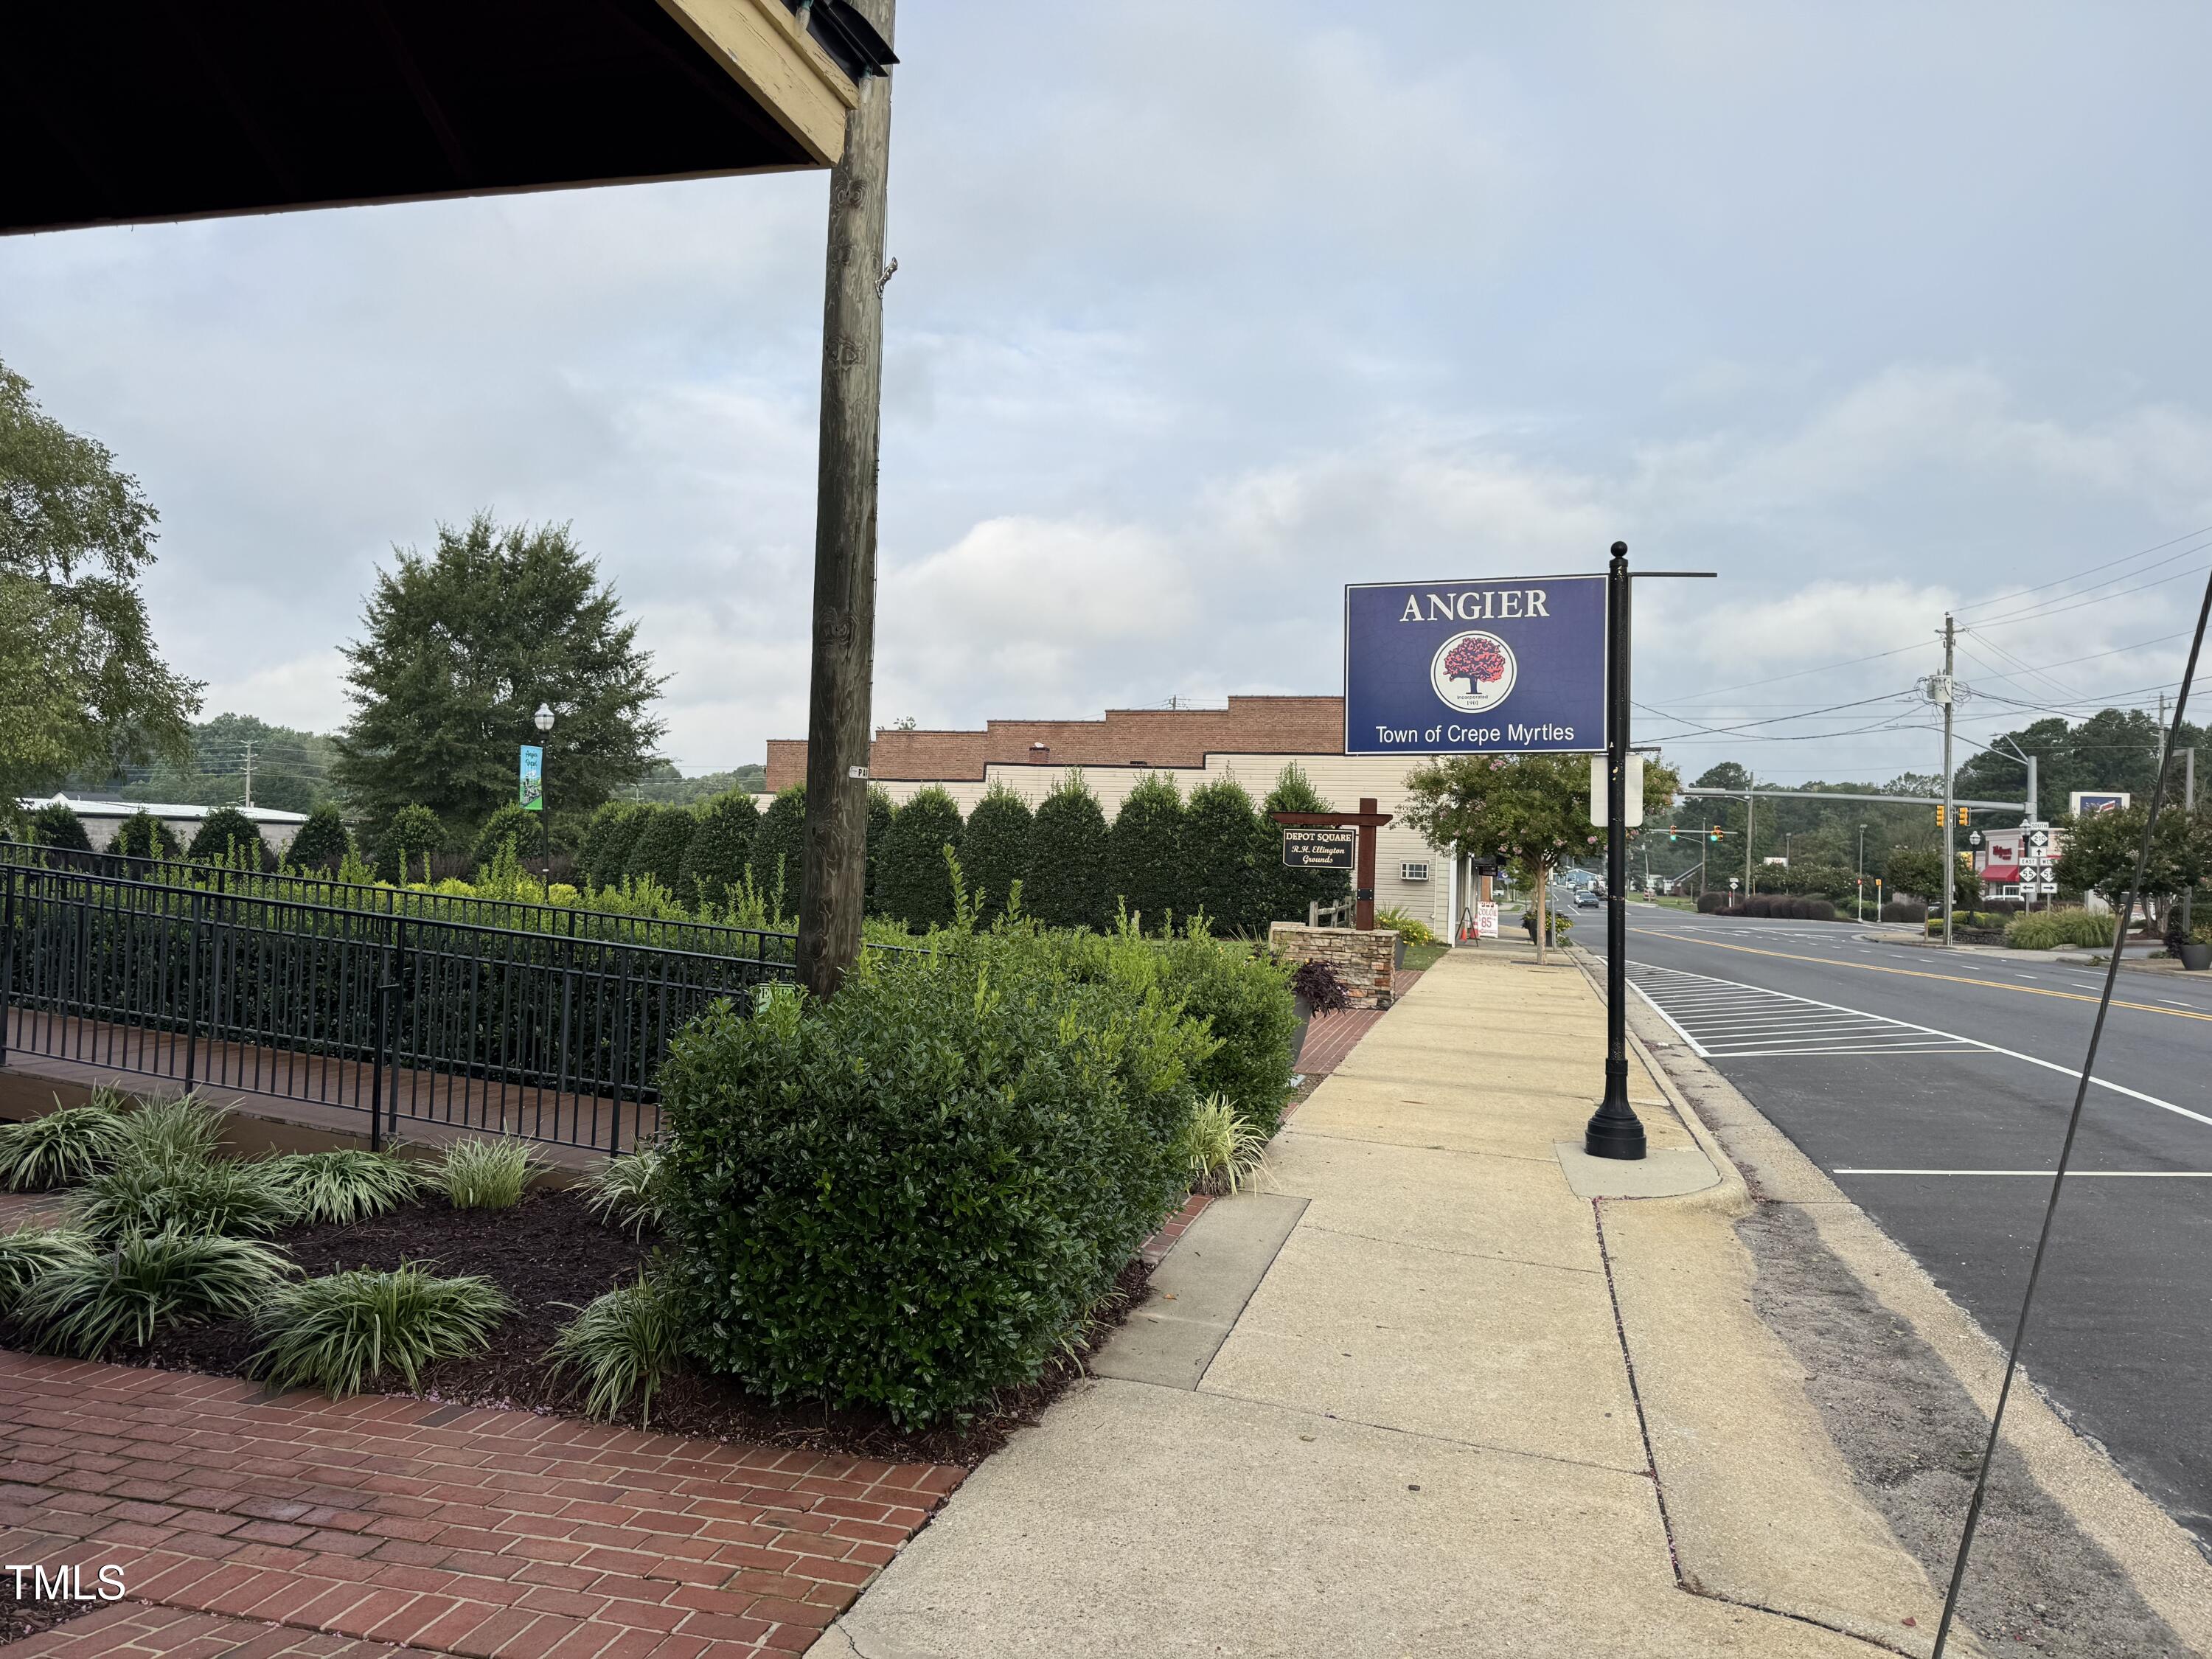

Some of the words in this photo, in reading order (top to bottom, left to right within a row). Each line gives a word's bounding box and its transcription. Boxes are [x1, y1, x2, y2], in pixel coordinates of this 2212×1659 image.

[1399, 589, 1550, 622] ANGIER
[1375, 726, 1418, 743] Town
[1425, 725, 1442, 742] of
[1447, 724, 1500, 746] Crepe
[1508, 723, 1575, 745] Myrtles
[1286, 832, 1315, 841] DEPOT
[1317, 833, 1352, 842] SQUARE
[1312, 845, 1345, 855] Ellington
[1302, 855, 1334, 864] Grounds
